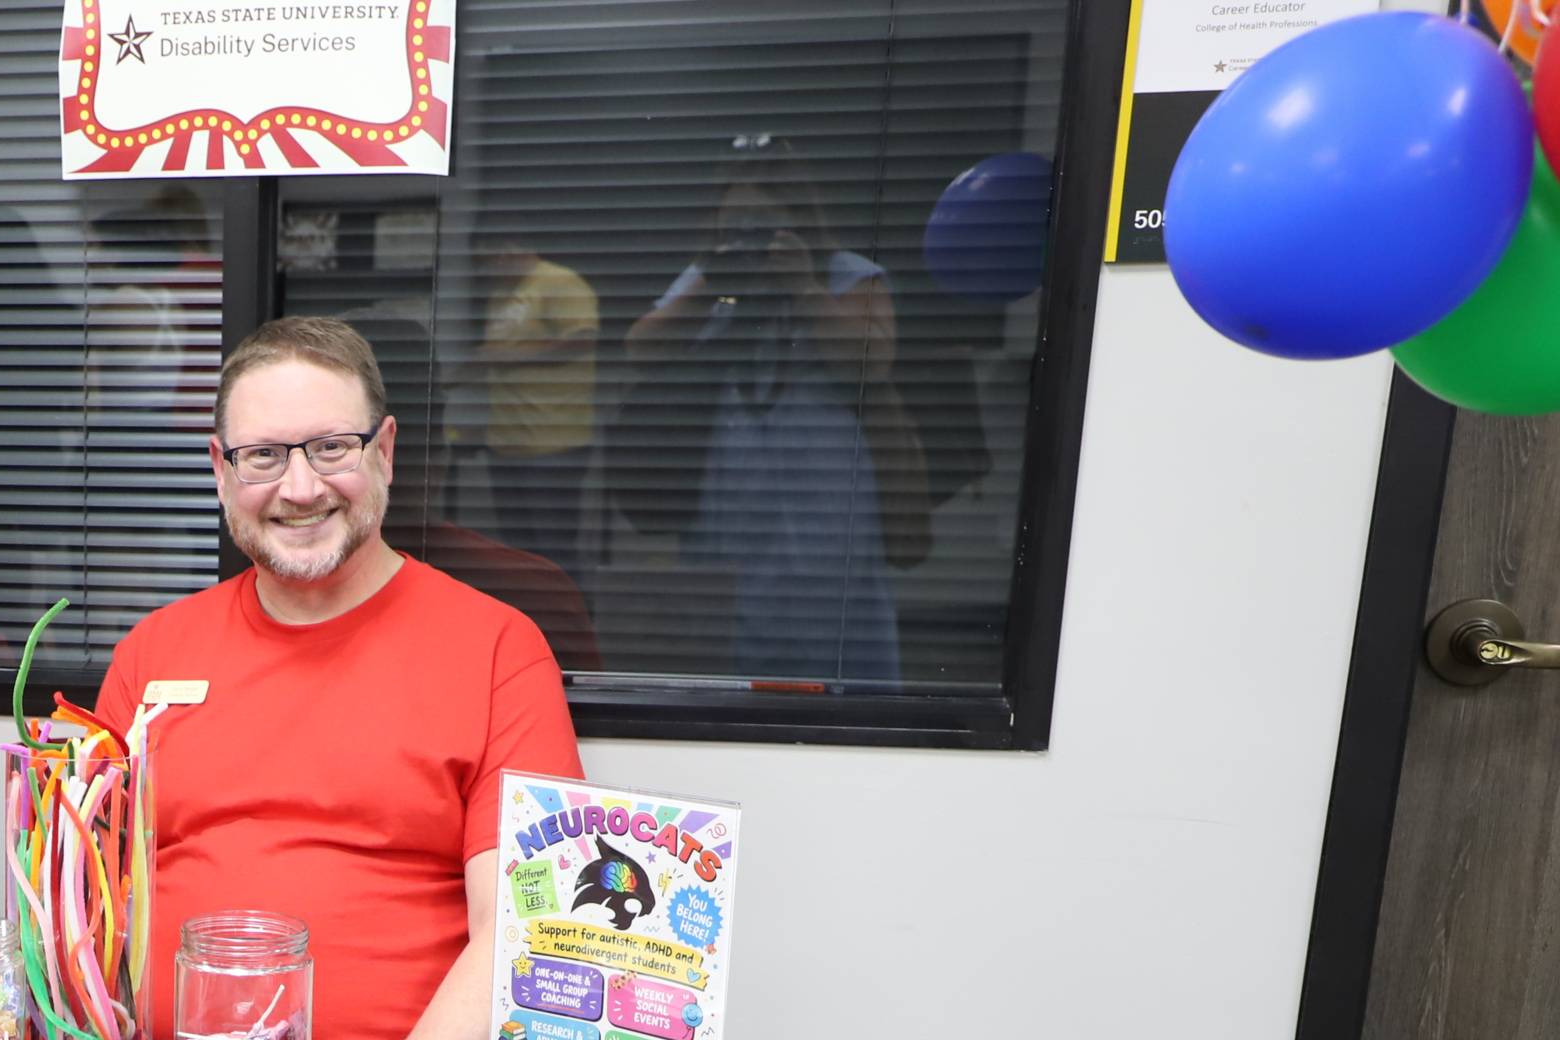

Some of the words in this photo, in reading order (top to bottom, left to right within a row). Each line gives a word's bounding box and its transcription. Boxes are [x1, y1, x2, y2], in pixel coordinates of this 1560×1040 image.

[160, 8, 217, 26] TEXAS
[221, 6, 277, 23] STATE
[281, 4, 398, 20] UNIVERSITY
[1212, 4, 1249, 16] Career
[1253, 1, 1306, 14] Educator
[1195, 23, 1226, 33] College
[1228, 22, 1238, 31] of
[1240, 21, 1268, 31] Health
[1269, 19, 1318, 29] Professions
[159, 34, 256, 59] Disability
[261, 32, 356, 53] Services
[515, 805, 723, 883] NEUROCATS
[515, 868, 547, 883] Different
[520, 880, 541, 894] NOT
[524, 896, 546, 909] LESS
[688, 893, 708, 912] YOU
[676, 905, 713, 928] BELONG
[679, 921, 709, 943] HERE!
[538, 922, 577, 939] Support
[581, 929, 596, 940] for
[645, 941, 673, 957] ADHD
[675, 952, 695, 964] and
[554, 941, 628, 963] neurodivergent
[632, 954, 677, 974] students
[535, 967, 583, 983] ONE-ON-ONE
[535, 980, 560, 993] SMALL
[563, 985, 589, 998] GROUP
[634, 986, 674, 1003] WEEKLY
[541, 992, 581, 1008] COACHING
[635, 999, 669, 1016] SOCIAL
[634, 1013, 671, 1029] EVENTS
[531, 1021, 574, 1040] RESEARCH
